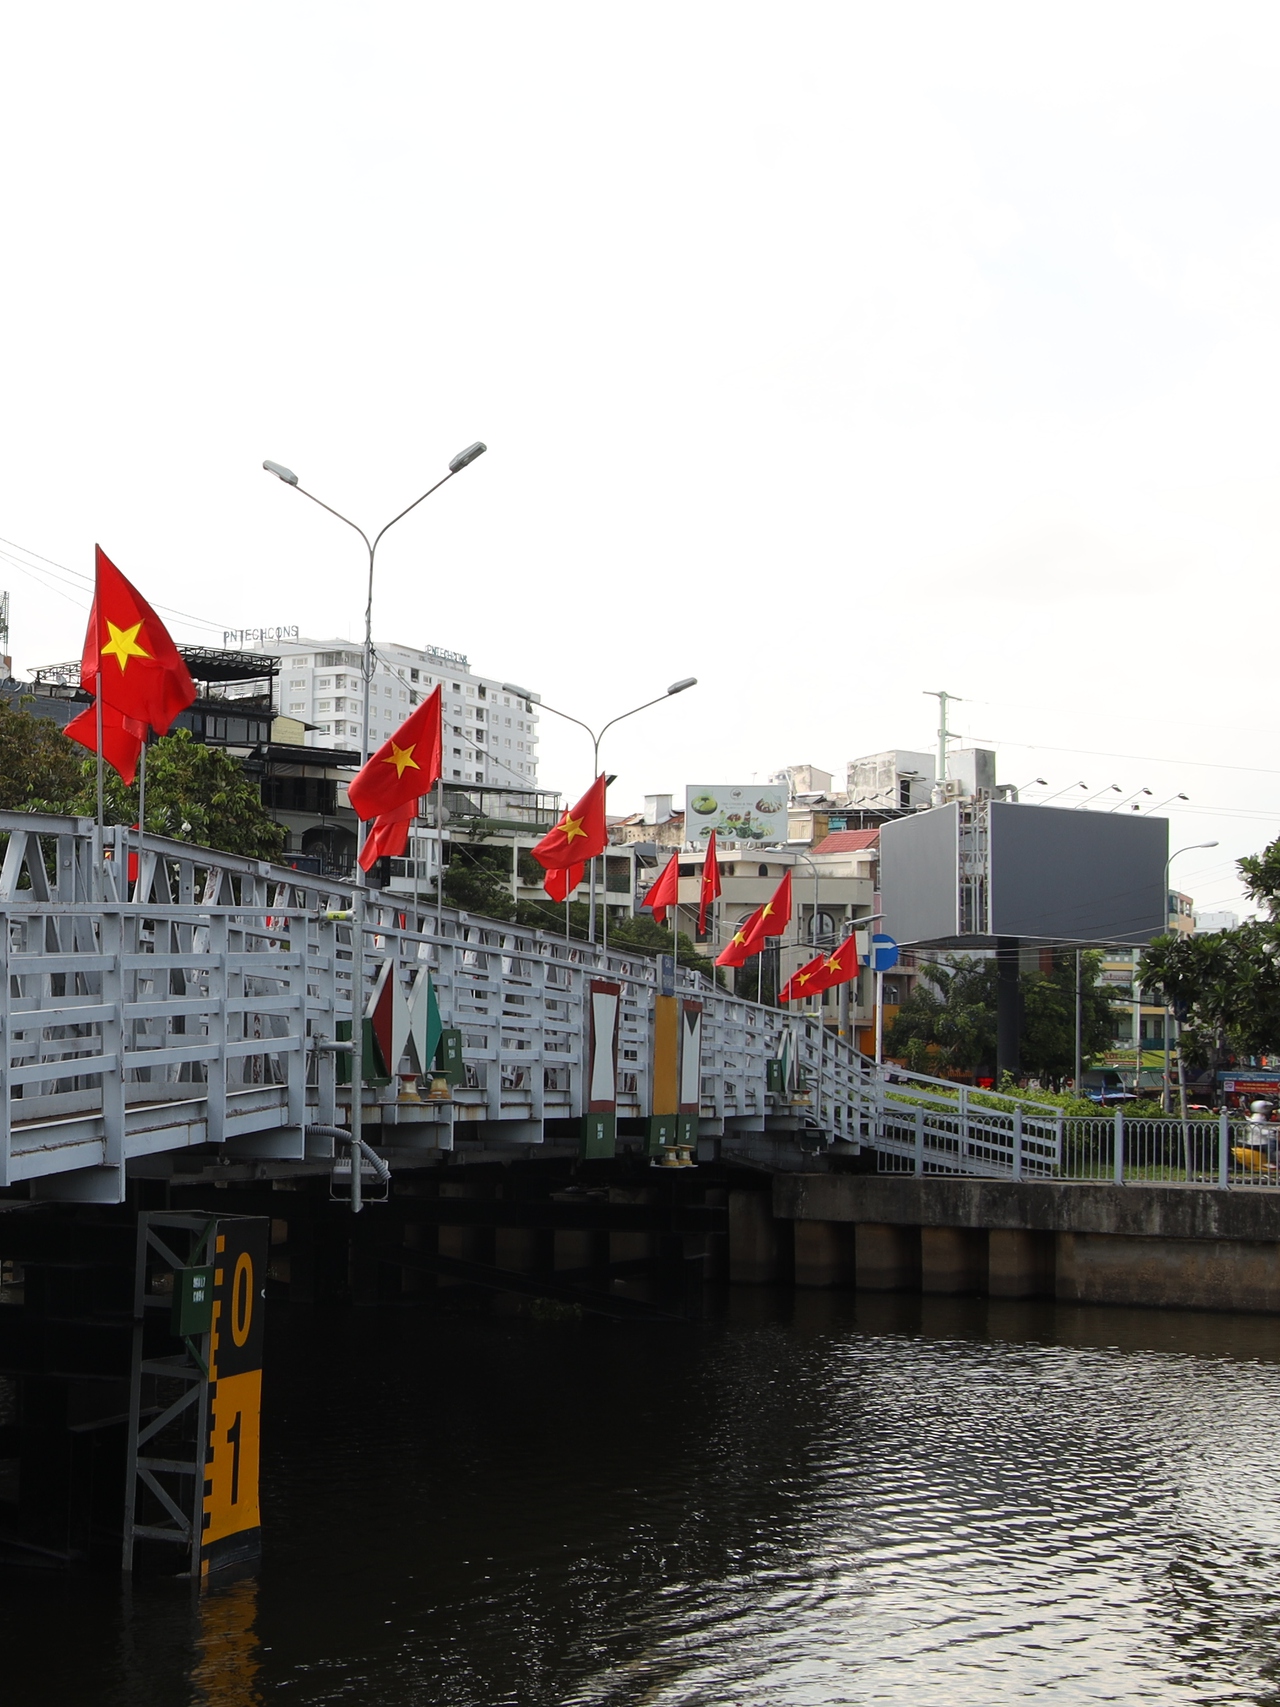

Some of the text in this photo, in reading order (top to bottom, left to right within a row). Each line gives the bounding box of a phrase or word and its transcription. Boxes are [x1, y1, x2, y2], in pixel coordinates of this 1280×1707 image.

[223, 625, 299, 643] PNTECHCONS
[231, 1252, 254, 1347] 0
[226, 1411, 241, 1506] 1
